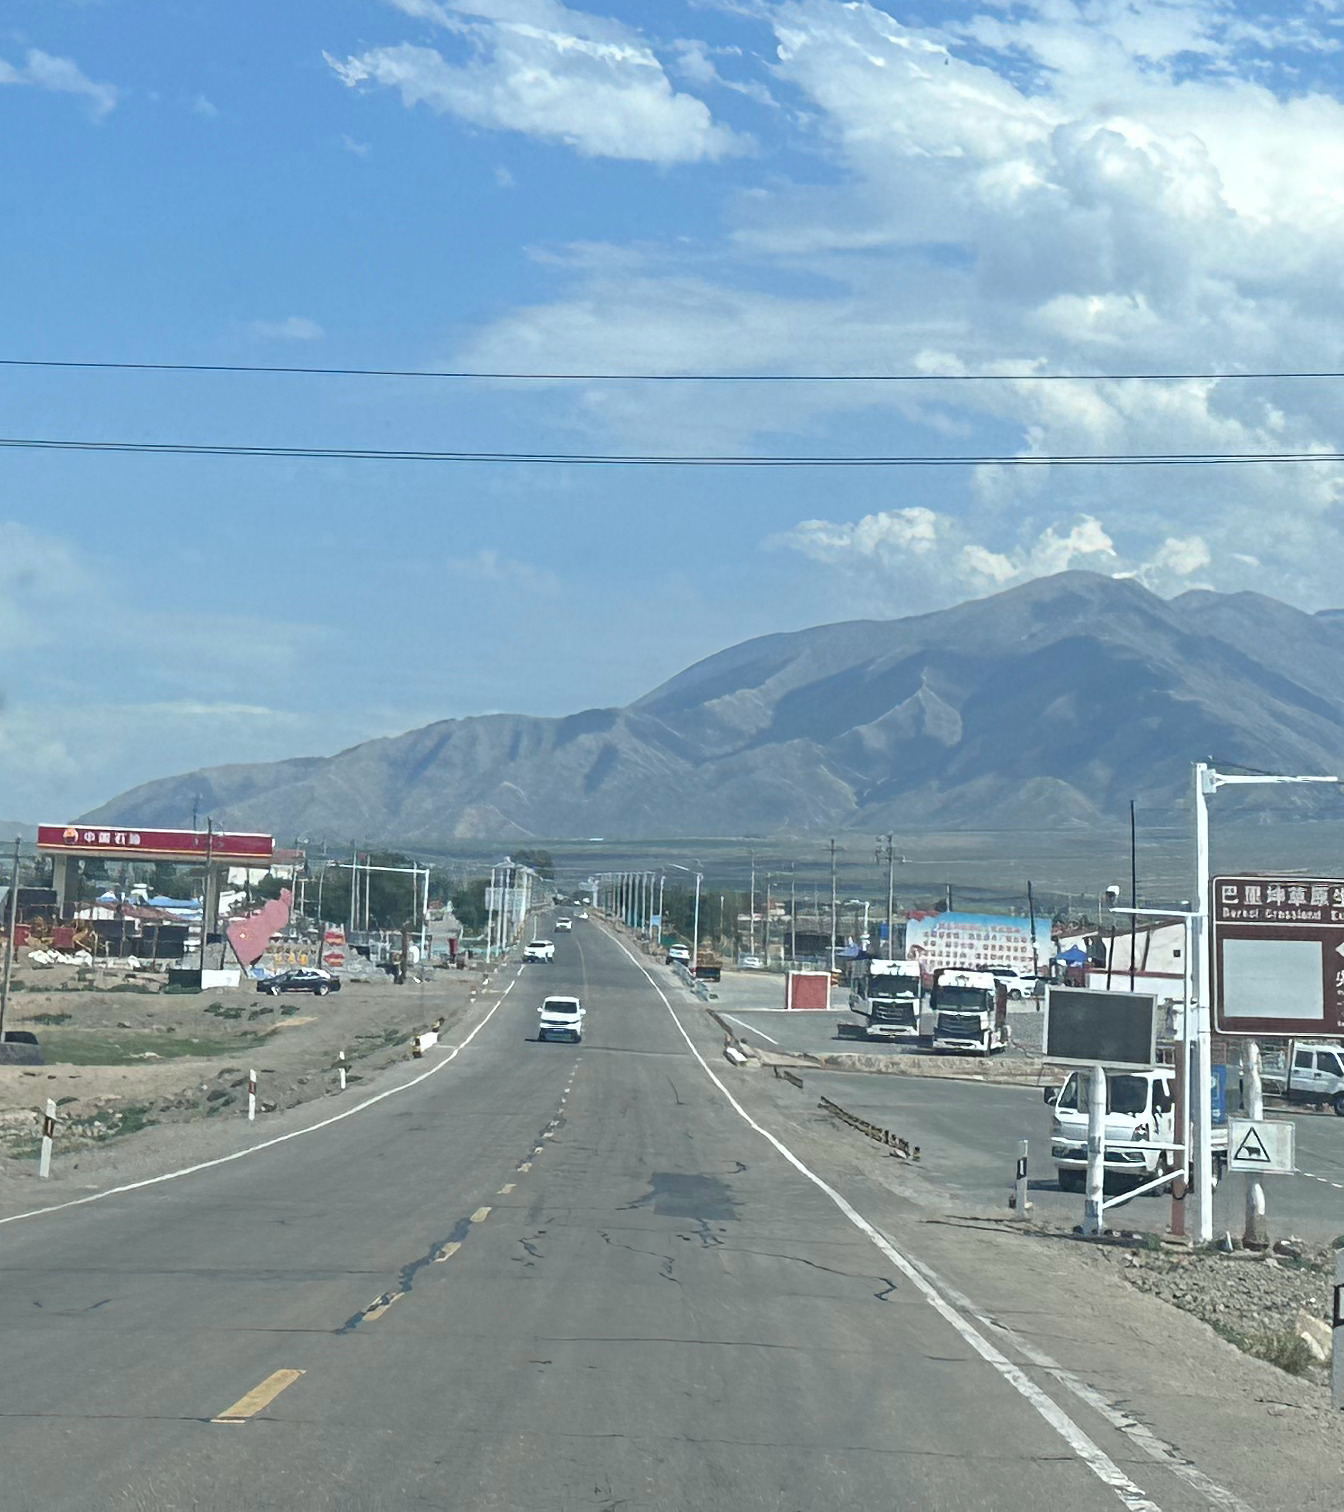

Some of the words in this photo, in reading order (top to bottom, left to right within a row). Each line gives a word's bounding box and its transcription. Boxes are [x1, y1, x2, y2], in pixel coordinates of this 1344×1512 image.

[84, 831, 141, 845] 中国石油
[1265, 908, 1321, 920] Grassland
